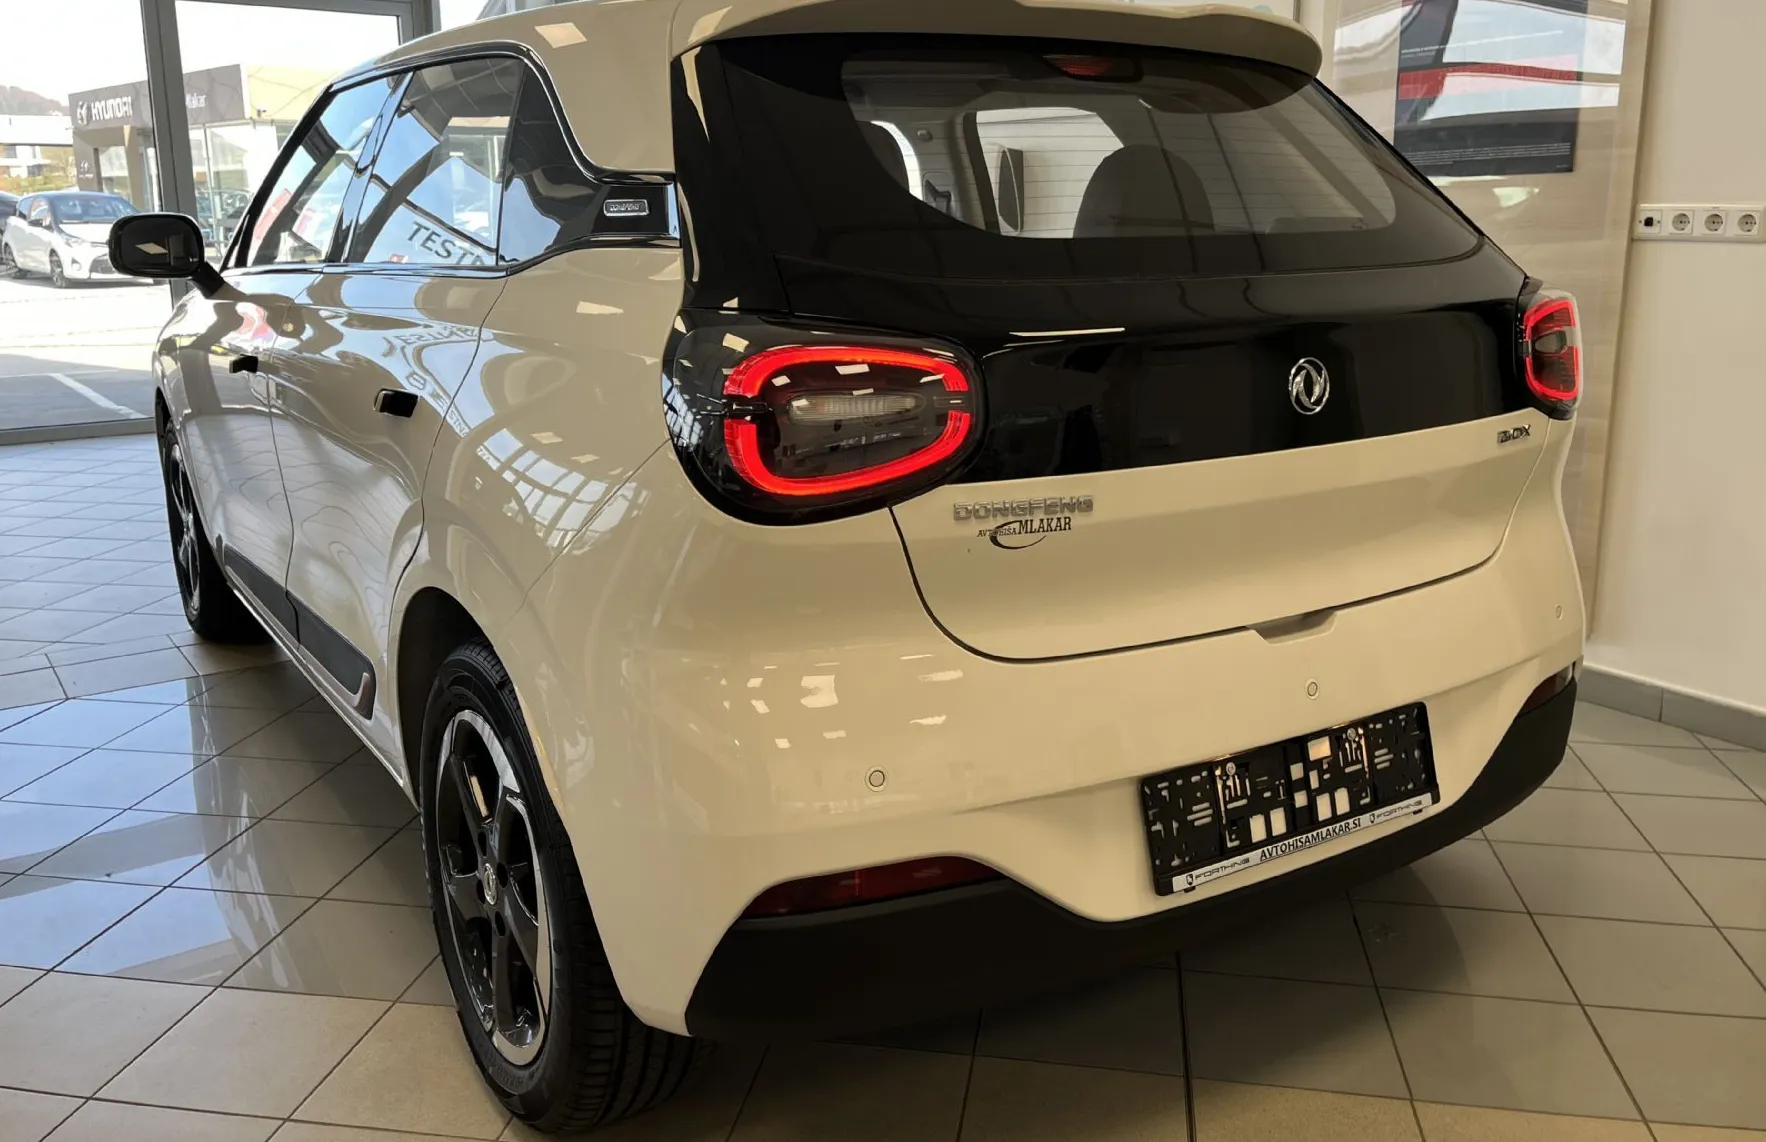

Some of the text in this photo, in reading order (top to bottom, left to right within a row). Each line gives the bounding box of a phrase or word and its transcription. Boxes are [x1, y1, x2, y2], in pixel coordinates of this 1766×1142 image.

[91, 95, 133, 121] HYUNDAI
[953, 494, 1094, 521] DONGFENG
[1017, 516, 1072, 535] MLAKAR
[1195, 800, 1423, 880] FORTHING AVTOHISAMLAKAR.SI FORTHING
